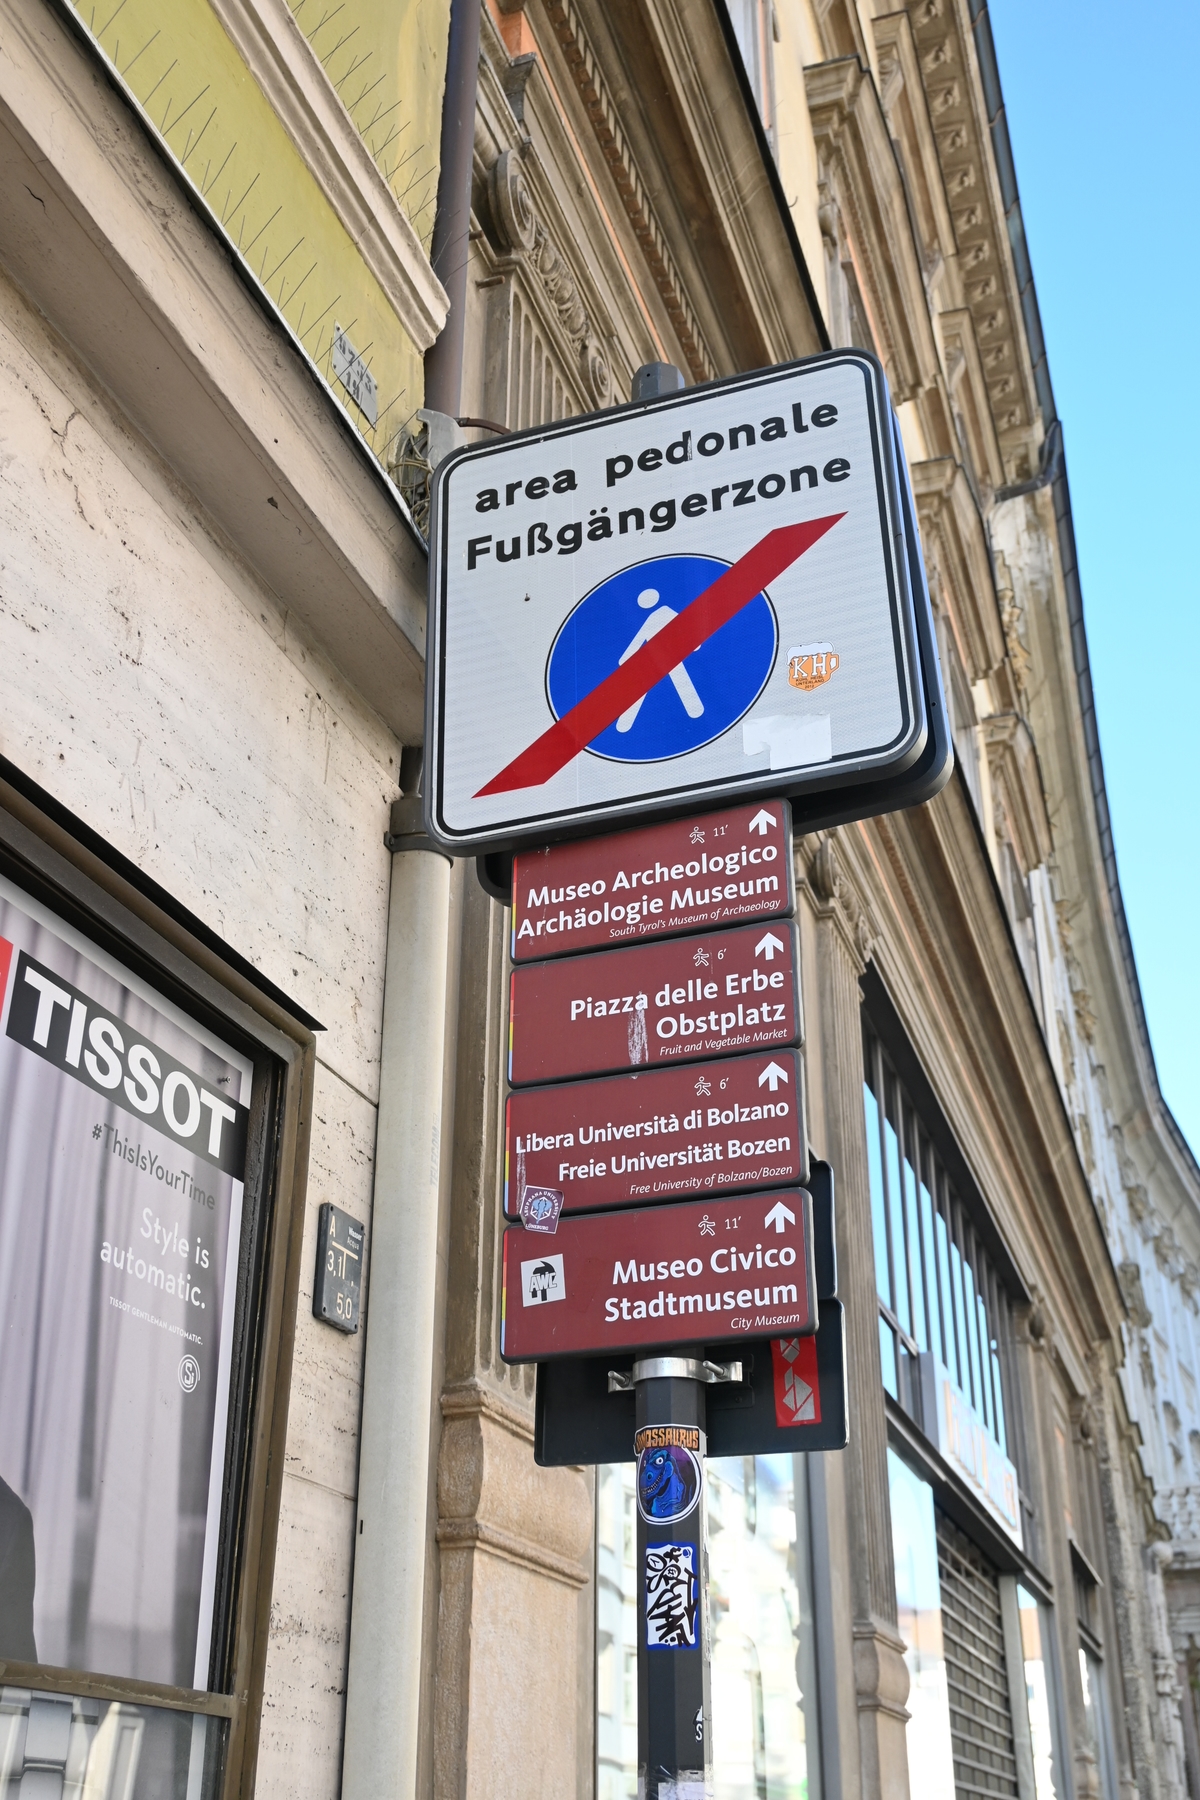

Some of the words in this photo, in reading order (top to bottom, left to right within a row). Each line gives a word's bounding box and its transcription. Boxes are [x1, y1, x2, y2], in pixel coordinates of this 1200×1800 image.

[476, 470, 578, 513] area
[606, 403, 838, 486] pedonale
[468, 455, 850, 570] Fußgängerzone
[792, 654, 827, 679] KH
[528, 880, 605, 908] Museo
[612, 846, 778, 893] Archeologico
[518, 895, 663, 939] Archäologie
[671, 876, 780, 911] Museum
[610, 925, 635, 937] South
[639, 920, 665, 933] Tyrol's
[669, 914, 707, 926] Museum
[711, 908, 721, 920] of
[722, 900, 780, 916] Archaeology
[570, 993, 648, 1021] Piazza
[655, 979, 718, 1006] delle
[726, 969, 784, 995] Erbe
[657, 1003, 785, 1041] Obstplatz
[660, 1045, 681, 1055] Fruit
[684, 1041, 702, 1052] and
[705, 1034, 750, 1049] Vegetable
[753, 1029, 787, 1041] Market
[24, 966, 235, 1159] TISSOT
[516, 1132, 573, 1153] Libera
[580, 1114, 679, 1144] Università
[684, 1110, 701, 1129] di
[708, 1103, 788, 1126] Bolzano
[92, 1121, 216, 1212] #ThisIsYourTime
[560, 1159, 606, 1181] Freie
[612, 1143, 723, 1173] Universität
[728, 1137, 790, 1158] Bozen
[630, 1185, 650, 1194] Free
[654, 1178, 702, 1191] University
[705, 1174, 716, 1187] of
[718, 1167, 792, 1183] Bolzano/Bozen
[329, 1215, 336, 1237] A
[524, 1191, 543, 1217] LEUPHANA
[543, 1191, 559, 1219] UNIVERSITY
[140, 1207, 188, 1257] Style
[195, 1237, 210, 1269] is
[100, 1238, 206, 1309] automatic.
[327, 1250, 342, 1277] 3,1
[613, 1258, 702, 1284] Museo
[711, 1244, 796, 1273] Civico
[110, 1296, 131, 1312] TISSOT
[132, 1307, 167, 1329] GENTLEMAN
[168, 1325, 203, 1345] AUTOMATIC.
[337, 1292, 352, 1320] 5,0
[605, 1285, 799, 1324] Stadtmuseum
[731, 1318, 752, 1330] City
[755, 1314, 799, 1326] Museum
